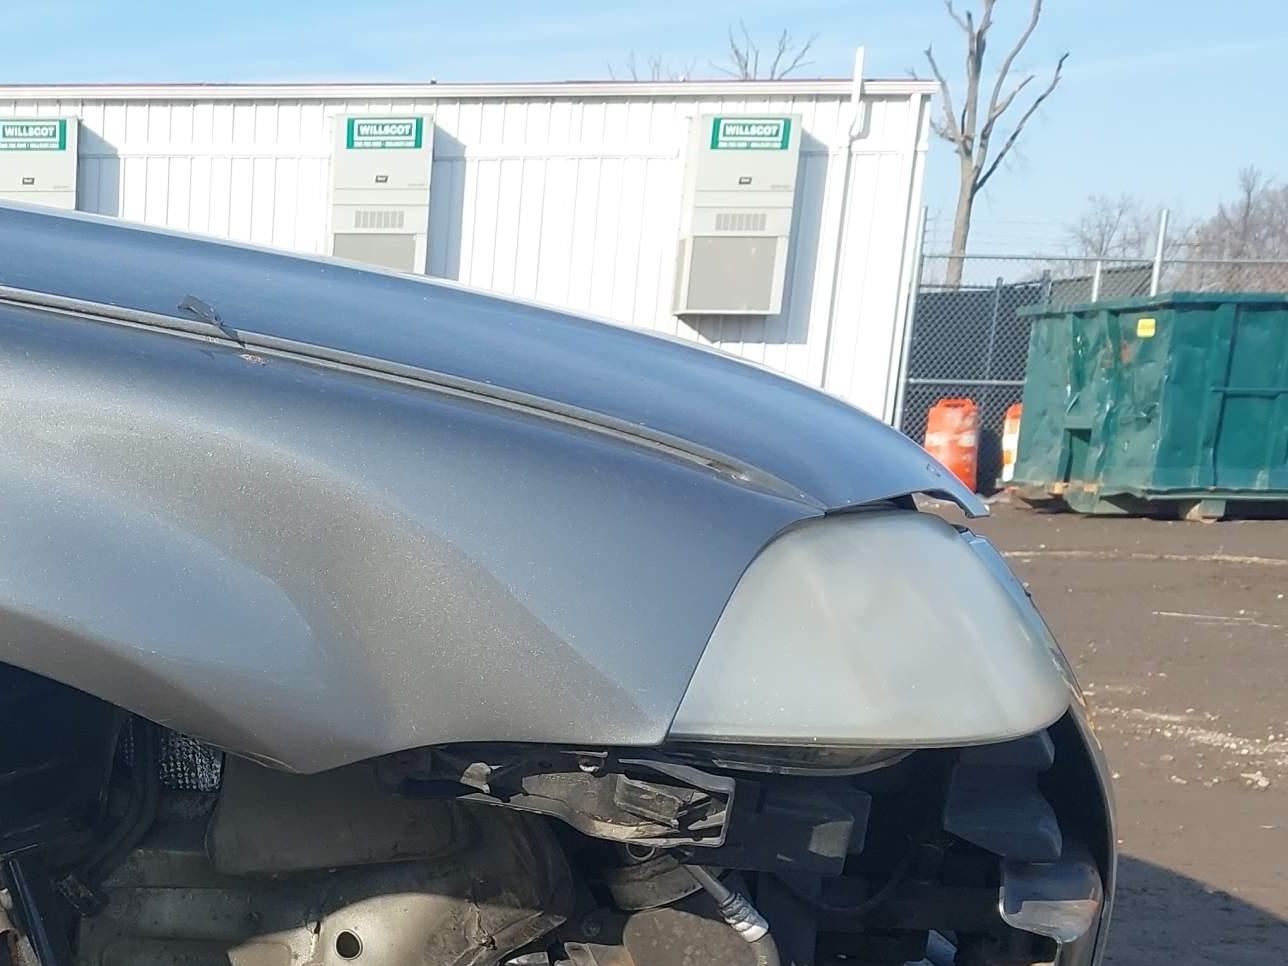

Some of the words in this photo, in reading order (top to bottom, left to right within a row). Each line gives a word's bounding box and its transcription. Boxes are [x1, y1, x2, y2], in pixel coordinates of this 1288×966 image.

[4, 126, 56, 137] WILLSCOT
[358, 124, 412, 135] WILLSCOT
[725, 124, 779, 136] WILLSCOT
